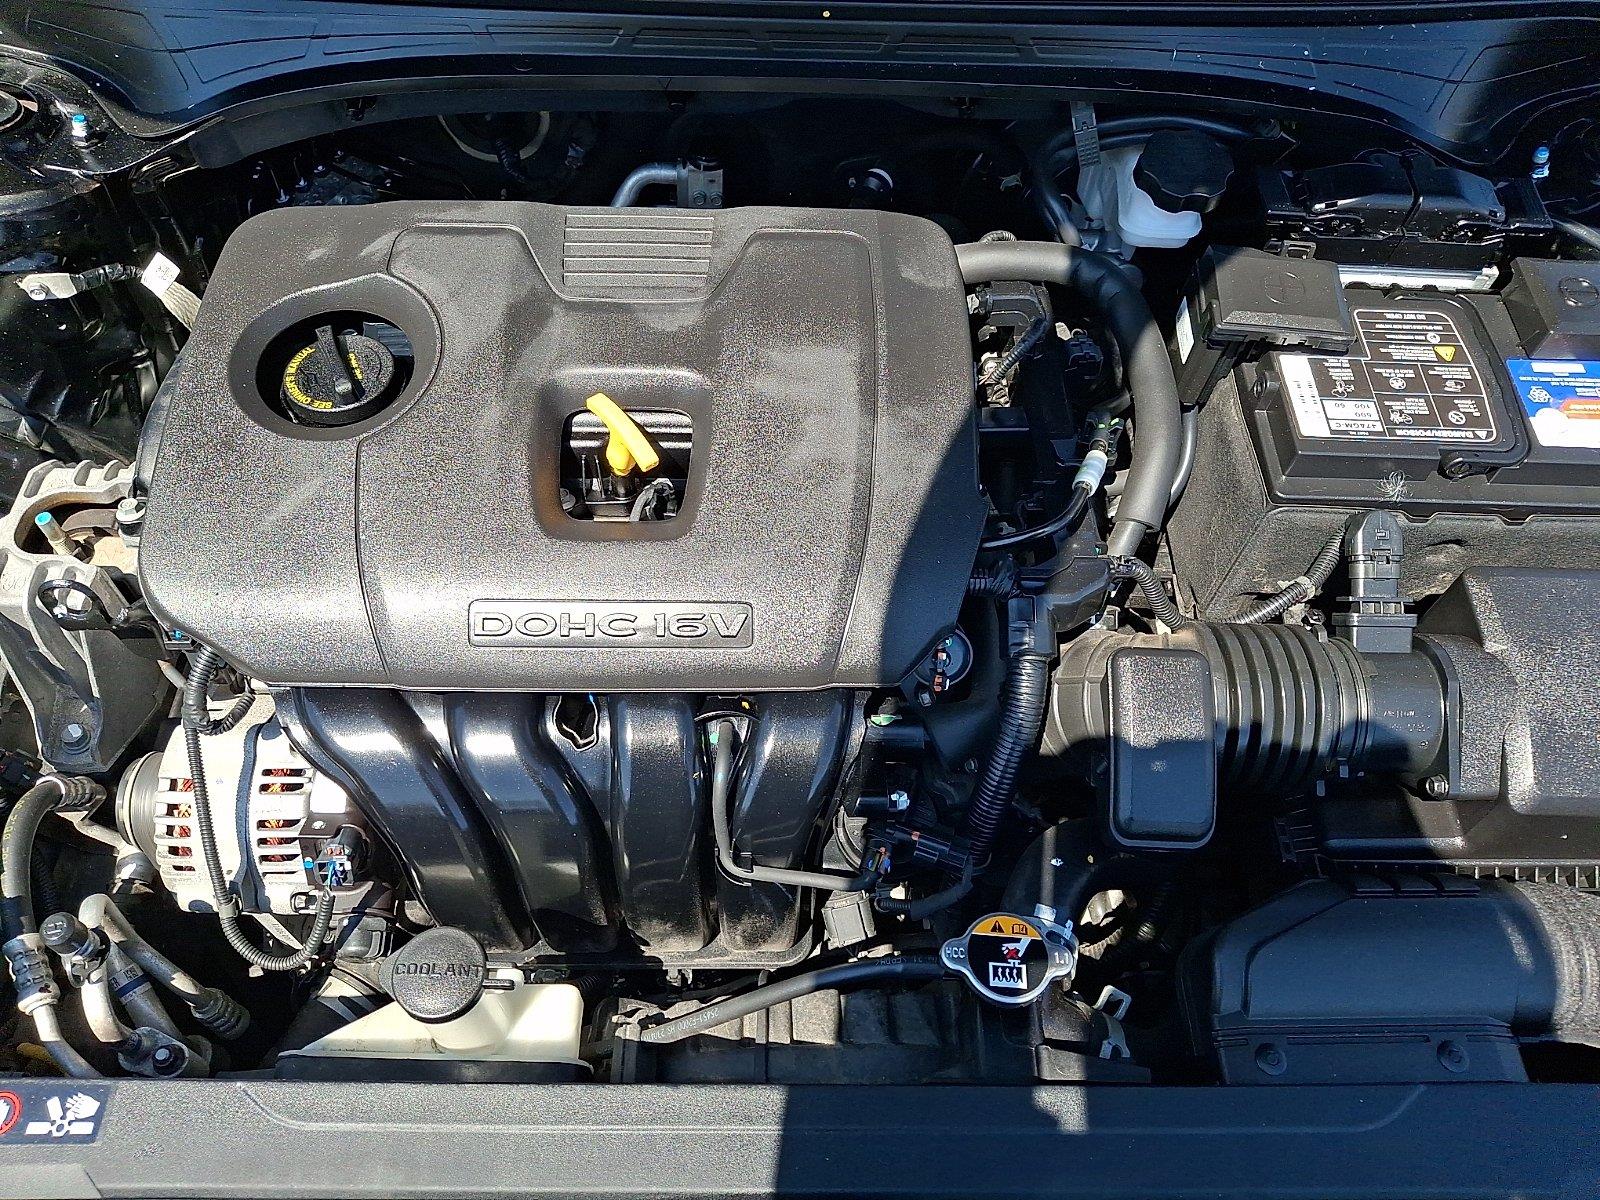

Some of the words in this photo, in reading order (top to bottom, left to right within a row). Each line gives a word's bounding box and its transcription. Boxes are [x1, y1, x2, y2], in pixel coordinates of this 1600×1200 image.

[286, 346, 316, 374] MANUAL
[312, 399, 333, 409] SEE
[473, 612, 638, 638] DOHC
[653, 612, 749, 638] 16V
[945, 946, 966, 960] HCC
[1053, 951, 1070, 965] 1.1
[395, 961, 484, 978] COOLANT
